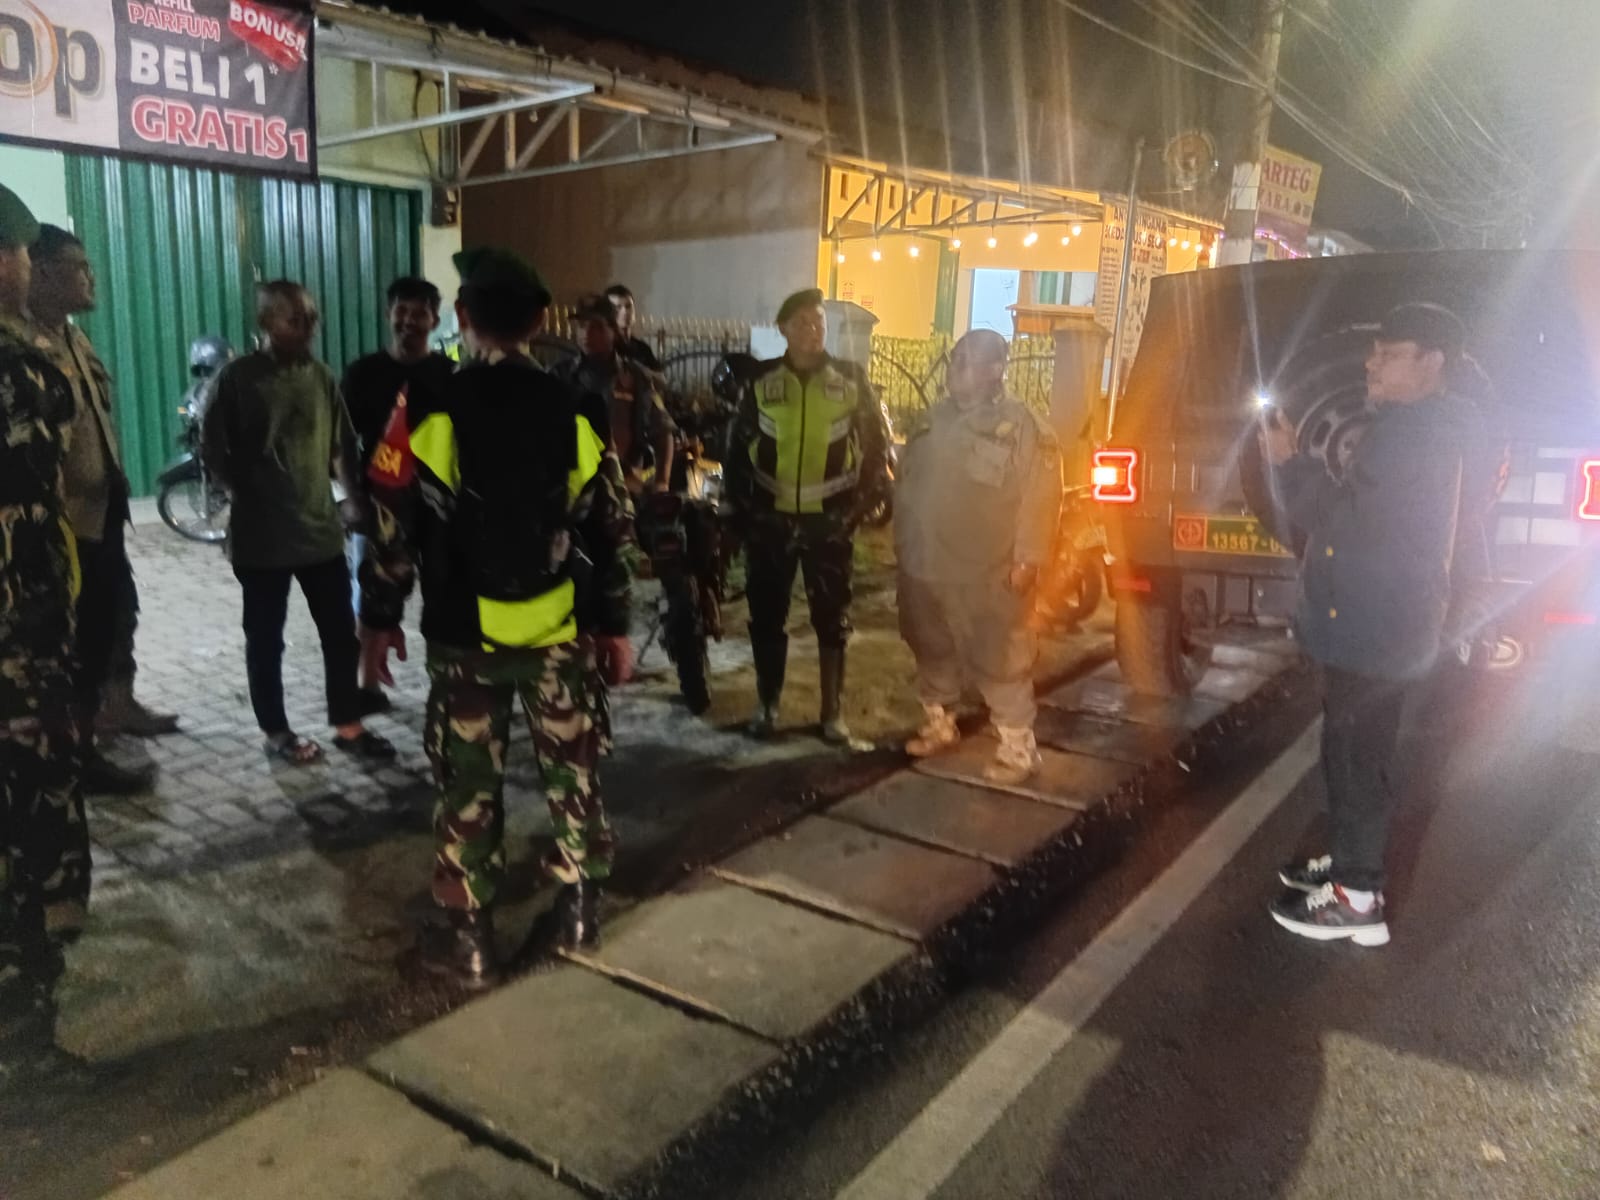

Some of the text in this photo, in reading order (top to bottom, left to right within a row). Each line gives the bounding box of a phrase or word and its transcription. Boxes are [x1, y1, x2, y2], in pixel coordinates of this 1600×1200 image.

[128, 2, 220, 42] PARFUM
[130, 39, 230, 98] BELI
[132, 95, 308, 162] GRATIS 1
